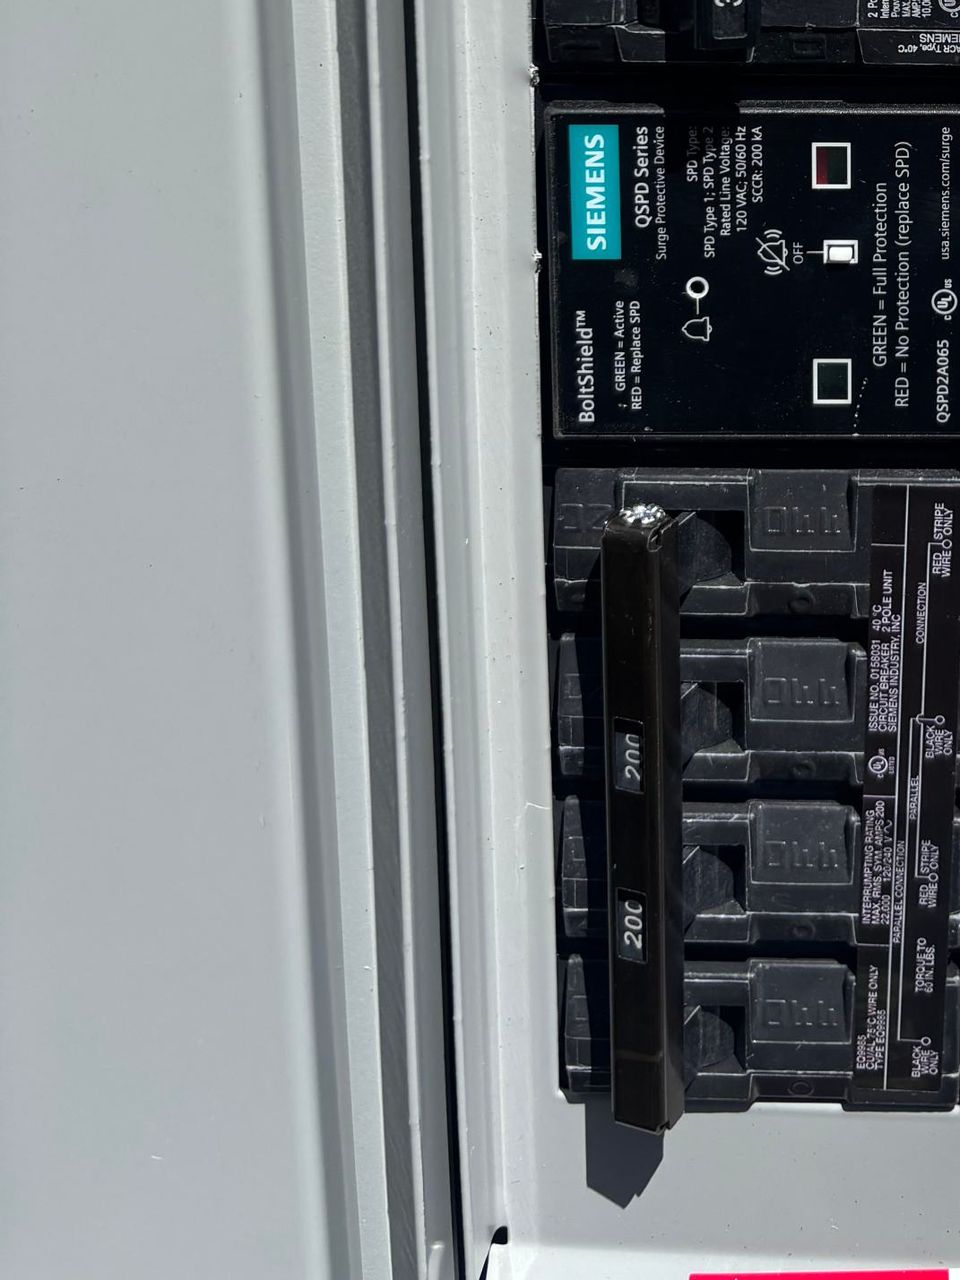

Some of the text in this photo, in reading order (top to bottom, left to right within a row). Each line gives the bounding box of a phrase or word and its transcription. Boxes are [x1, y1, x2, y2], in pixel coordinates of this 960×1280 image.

[633, 126, 652, 227] QSPD Series
[687, 160, 698, 181] SPD
[703, 167, 714, 189] SPD
[735, 126, 748, 232] 120 VAC; 50/60 Hz
[752, 127, 763, 203] SCCR: 200 kA
[585, 134, 606, 250] SIEMENS
[654, 126, 669, 260] Surge Protective Device
[704, 192, 716, 202] 1;
[720, 177, 730, 200] Line
[939, 127, 953, 260] usa.siemens.com/surge
[704, 207, 717, 232] Type
[720, 204, 731, 235] Rated
[704, 236, 715, 257] SPD
[793, 242, 804, 264] OFF
[872, 183, 887, 367] GREEN Full Protection
[894, 142, 913, 407] RED No Protection (replace SPD)
[613, 301, 625, 391] GREEN Active
[630, 301, 644, 409] RED Replace SPD
[936, 340, 950, 423] QSPD2A065
[933, 503, 944, 574] RED STRIPE
[942, 508, 953, 577] WIRE ONLY
[883, 570, 892, 593] UNIT
[872, 620, 881, 631] 40
[882, 597, 891, 623] POLE
[916, 583, 926, 644] CONNECTION
[880, 643, 889, 689] BREAKER
[890, 635, 900, 686] INDUSTRY,
[870, 683, 879, 699] NO.
[869, 703, 878, 731] ISSUE
[879, 692, 888, 731] CIRCUIT
[889, 688, 897, 732] SIEMENS
[926, 726, 935, 758] BLACK
[944, 730, 953, 755] ONLY
[876, 801, 884, 817] 200
[910, 776, 919, 819] PARALLEL
[865, 810, 874, 843] RATING
[875, 820, 883, 846] AMPS
[884, 847, 892, 882] 120/240
[920, 840, 930, 905] RED STRIPE
[928, 844, 938, 908] WIRE ONLY
[873, 874, 882, 897] RMS.
[893, 841, 905, 943] PARALLEL CONNECTION
[872, 900, 880, 924] MAX.
[915, 938, 926, 993] TORQUE TO
[926, 945, 935, 965] LBS.
[870, 965, 878, 989] ONLY
[868, 992, 877, 1015] WIRE
[866, 1042, 875, 1070] CU/AL
[875, 1046, 884, 1070] TYPE
[912, 1046, 921, 1078] BLACK
[921, 1050, 930, 1074] WIRE
[930, 1050, 939, 1075] ONLY
